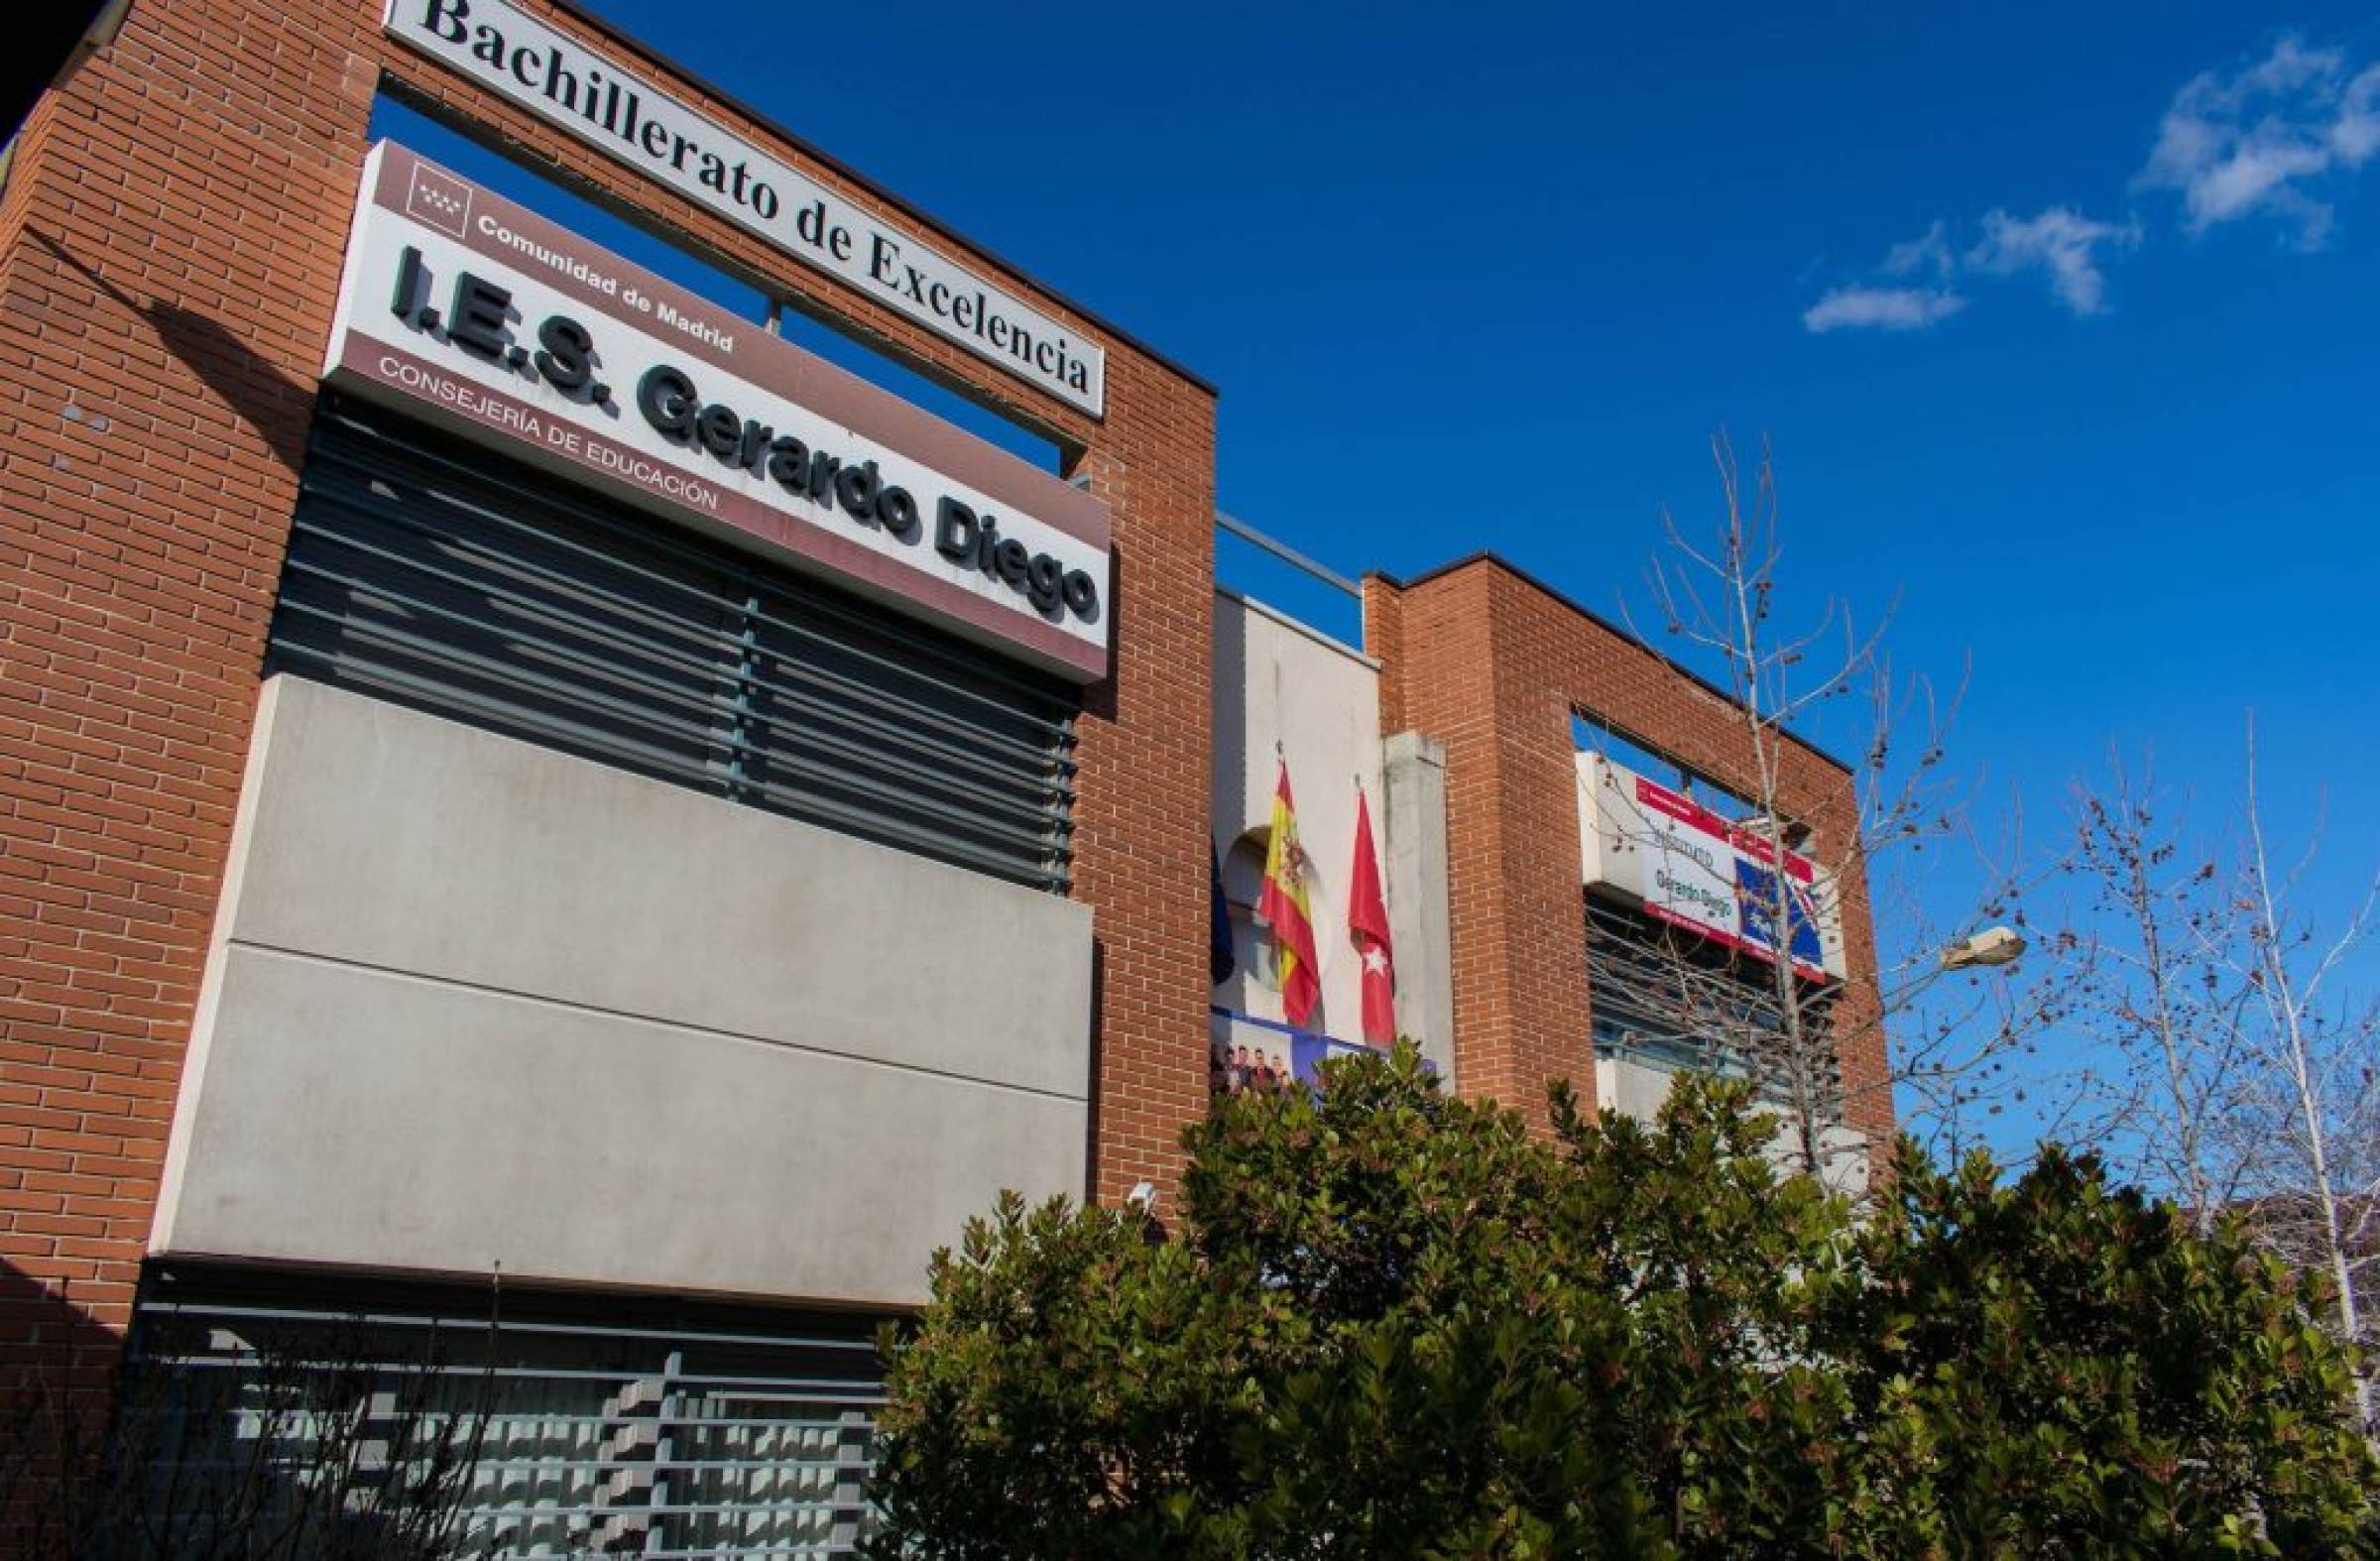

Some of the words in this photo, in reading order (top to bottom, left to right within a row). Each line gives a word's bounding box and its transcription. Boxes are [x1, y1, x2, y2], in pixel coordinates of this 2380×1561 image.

[417, 0, 779, 220] Bachillerato
[796, 199, 852, 261] de
[868, 231, 1089, 395] Excelencia
[478, 214, 617, 296] Comunidad
[622, 283, 651, 312] de
[656, 301, 733, 353] Madrid
[379, 356, 541, 434] CONSEJERÍA
[547, 424, 580, 450] DE
[587, 440, 719, 511] EDUCACIÓN
[391, 245, 613, 405] I.E.S.
[636, 364, 920, 539] Gerardo
[934, 495, 1097, 616] Diego
